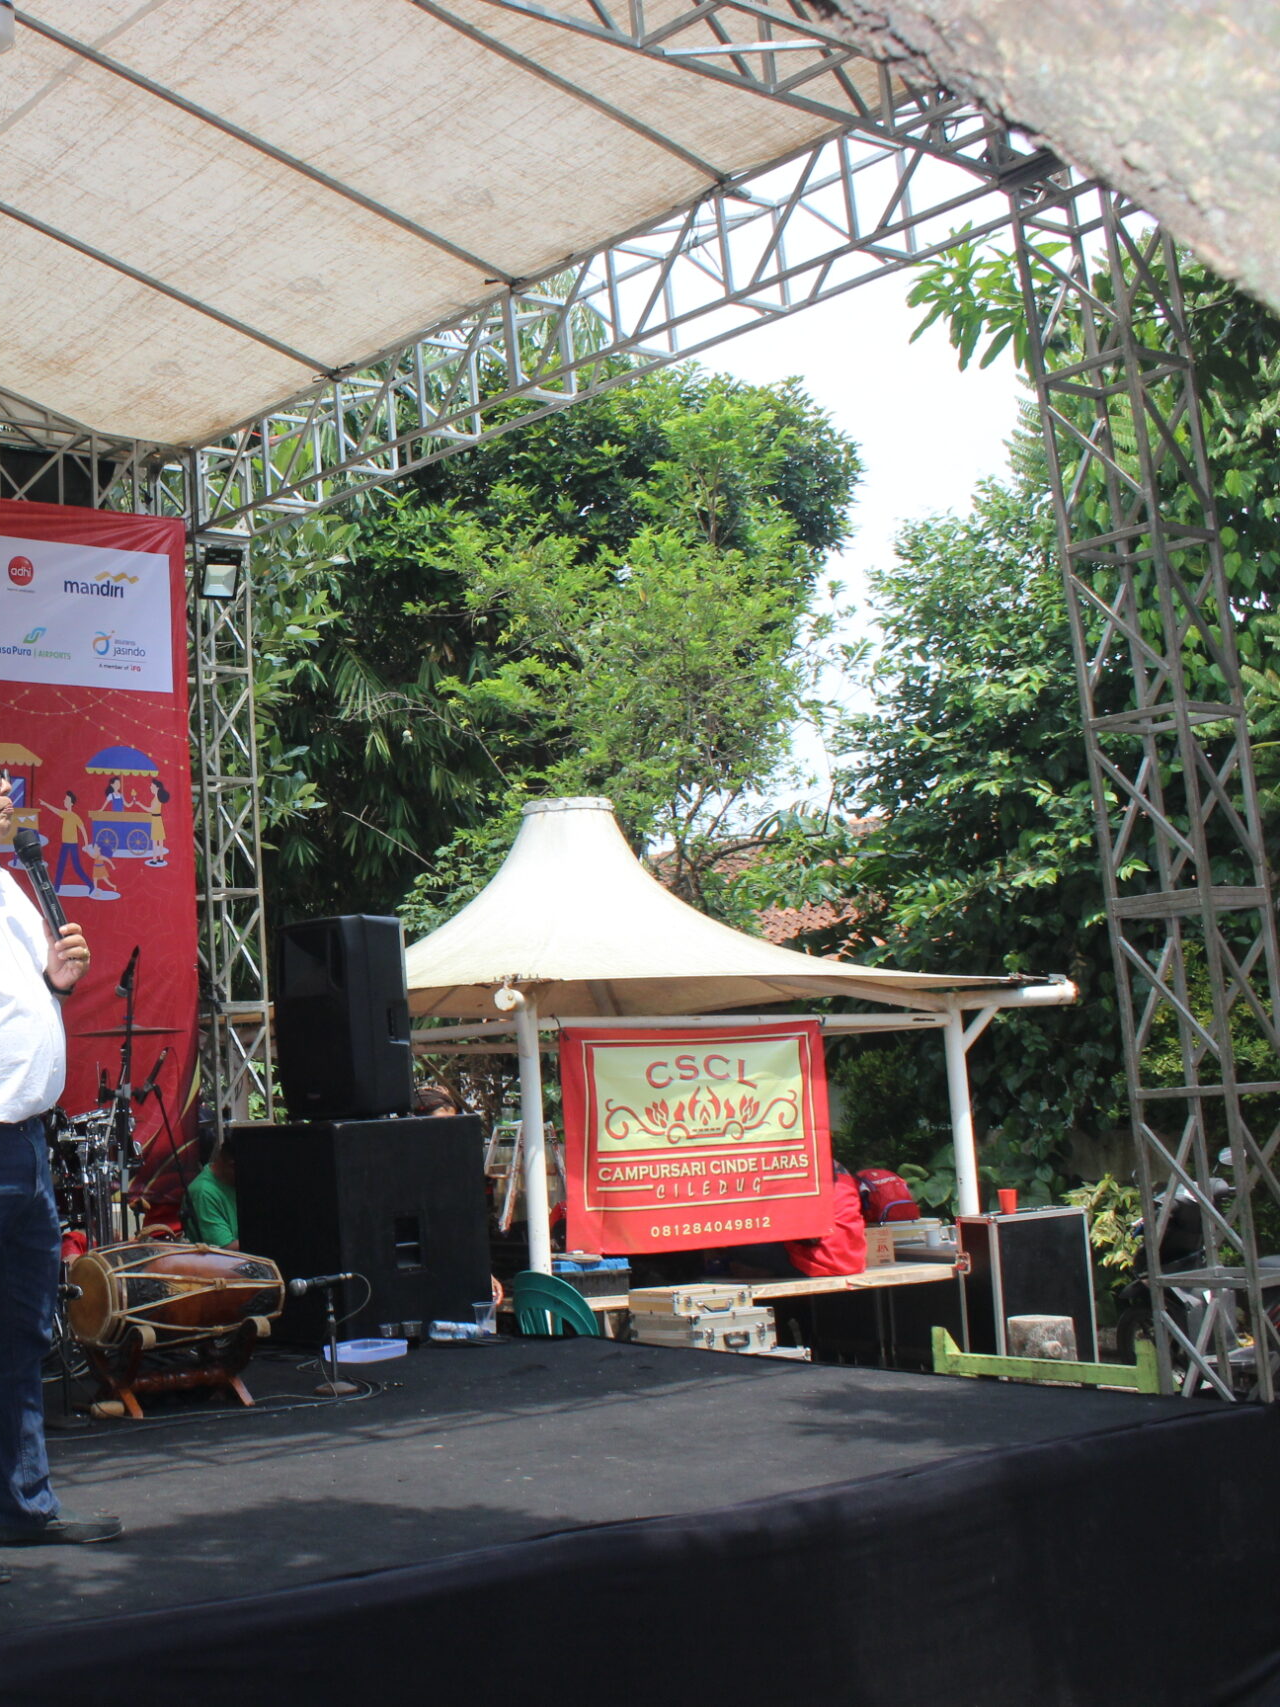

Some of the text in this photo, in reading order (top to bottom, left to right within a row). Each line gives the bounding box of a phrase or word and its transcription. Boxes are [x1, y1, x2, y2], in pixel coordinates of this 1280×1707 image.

[10, 564, 32, 578] adhi
[64, 580, 124, 599] mandiri
[113, 646, 146, 657] jasindo
[645, 1054, 757, 1089] CSCL
[598, 1154, 809, 1182] CAMPURSARI CINDE LARAS
[657, 1177, 761, 1200] CILEDUG
[650, 1217, 771, 1238] 081284049812
